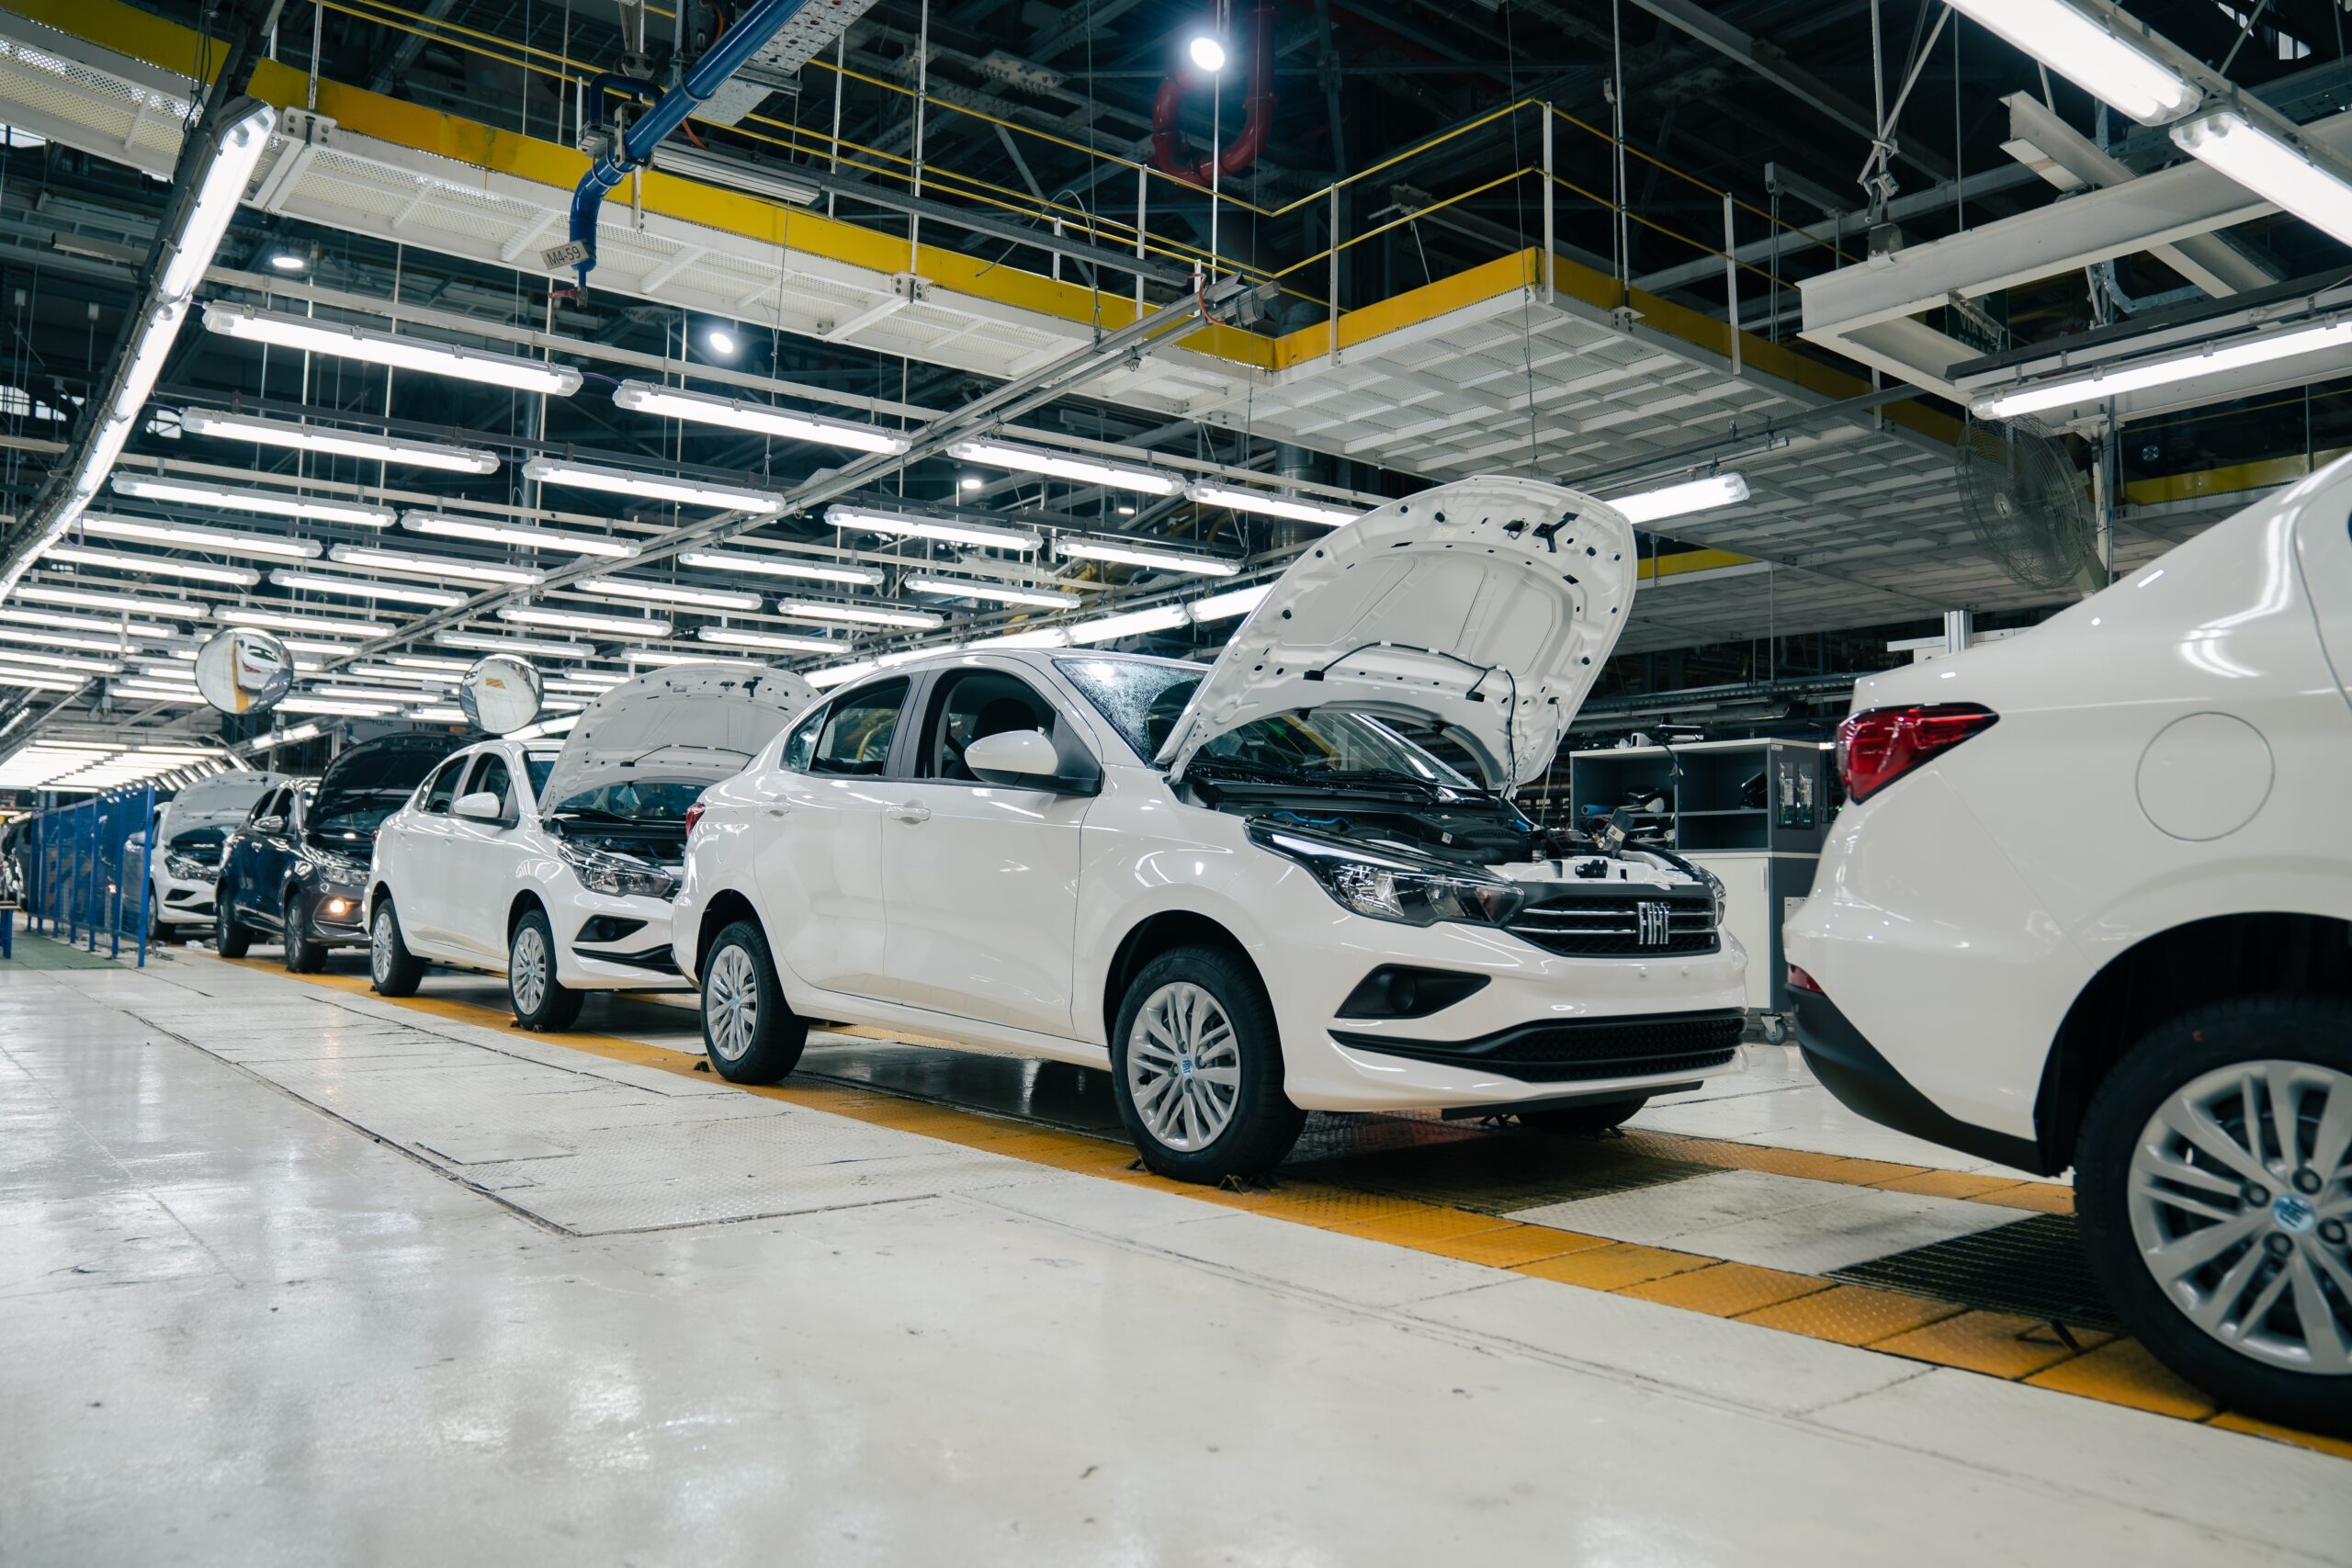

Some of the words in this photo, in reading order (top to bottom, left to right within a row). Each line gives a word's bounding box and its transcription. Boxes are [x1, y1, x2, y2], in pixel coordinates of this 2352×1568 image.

[547, 245, 581, 265] M4-59
[1959, 312, 1979, 336] VIA
[1637, 902, 1670, 944] FIAT
[1182, 1059, 1192, 1074] FIAT
